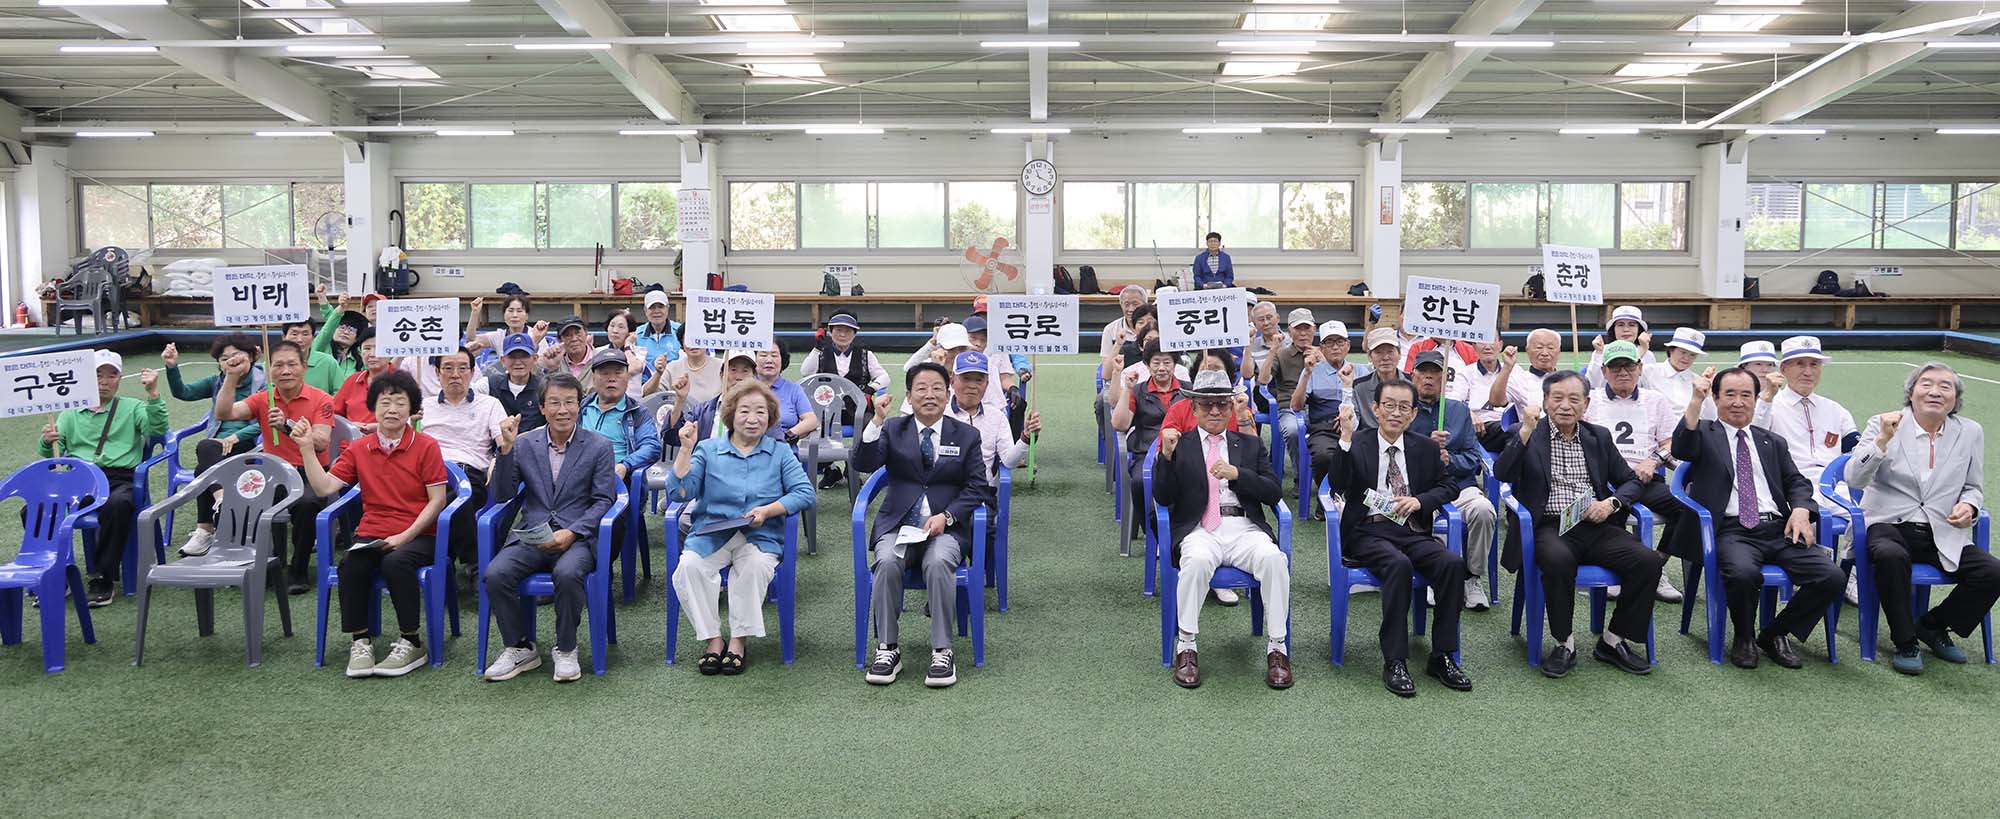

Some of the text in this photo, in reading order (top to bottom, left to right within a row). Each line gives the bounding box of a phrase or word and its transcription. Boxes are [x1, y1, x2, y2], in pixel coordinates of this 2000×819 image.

[1556, 262, 1591, 289] 춘광
[231, 282, 289, 310] 비래
[702, 308, 757, 335] 법동
[1175, 307, 1228, 335] 중리
[1422, 295, 1480, 326] 한남
[392, 315, 444, 342] 송촌
[1004, 314, 1062, 340] 금로
[13, 369, 78, 400] 구봉
[1615, 421, 1635, 445] 2
